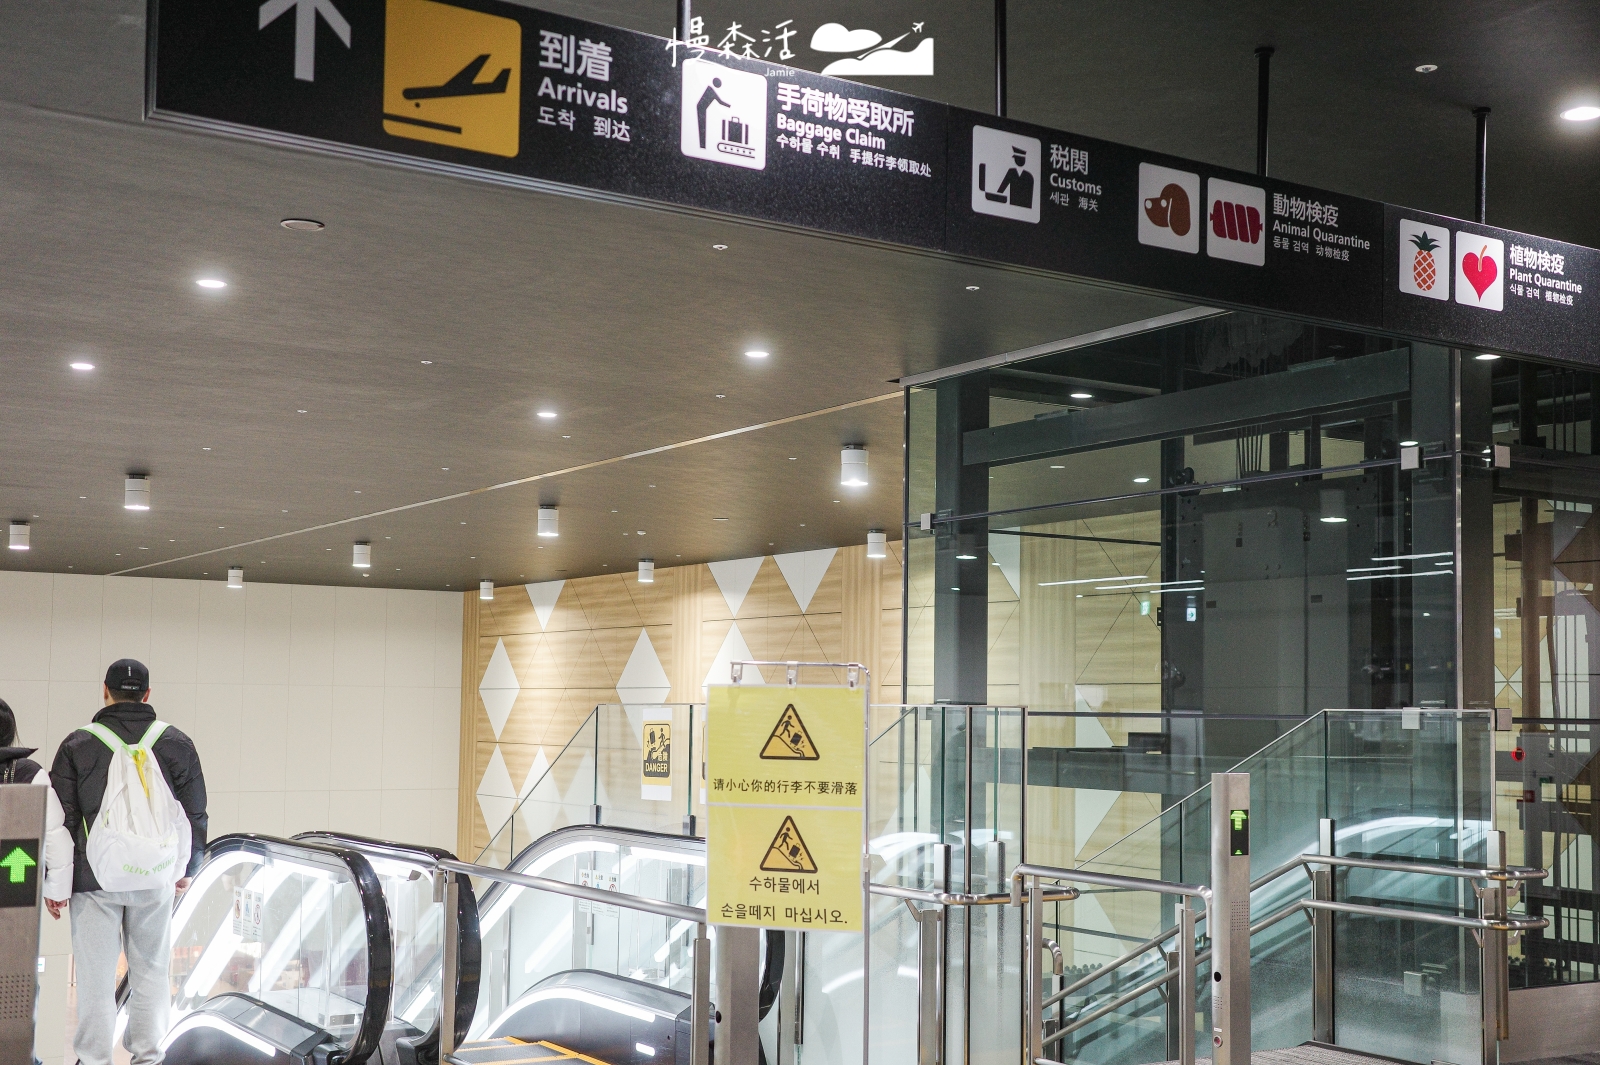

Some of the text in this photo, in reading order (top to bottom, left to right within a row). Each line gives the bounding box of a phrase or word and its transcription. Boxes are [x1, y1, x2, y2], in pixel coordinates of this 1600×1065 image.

[539, 29, 613, 81] 到着
[537, 76, 628, 114] Arrivals
[537, 106, 576, 131] 도착
[776, 82, 915, 137] 手荷物受取所
[593, 116, 631, 142] 到达
[776, 112, 886, 150] Baggage Claim
[776, 133, 841, 160] 수하물 수취
[1050, 144, 1089, 175] 税関
[850, 148, 932, 178] 手提行李领取处
[1049, 173, 1102, 196] Customs
[1049, 191, 1070, 207] 세관
[1078, 196, 1099, 212] 海关
[1272, 192, 1339, 228] 動物検疫
[1272, 219, 1371, 250] Animal Quarantine
[1273, 235, 1310, 254] 동물 검역
[1315, 244, 1350, 262] 动物检疫
[1510, 244, 1564, 275] 植物検疫
[1509, 267, 1582, 293] Plant Quarantine
[1509, 283, 1540, 300] 식물 검역
[646, 763, 667, 772] DANGER
[713, 778, 858, 796] 请小心你的行李不要滑落
[749, 876, 820, 895] 수하물에서
[721, 902, 848, 924] 손을떼지 마십시오.
